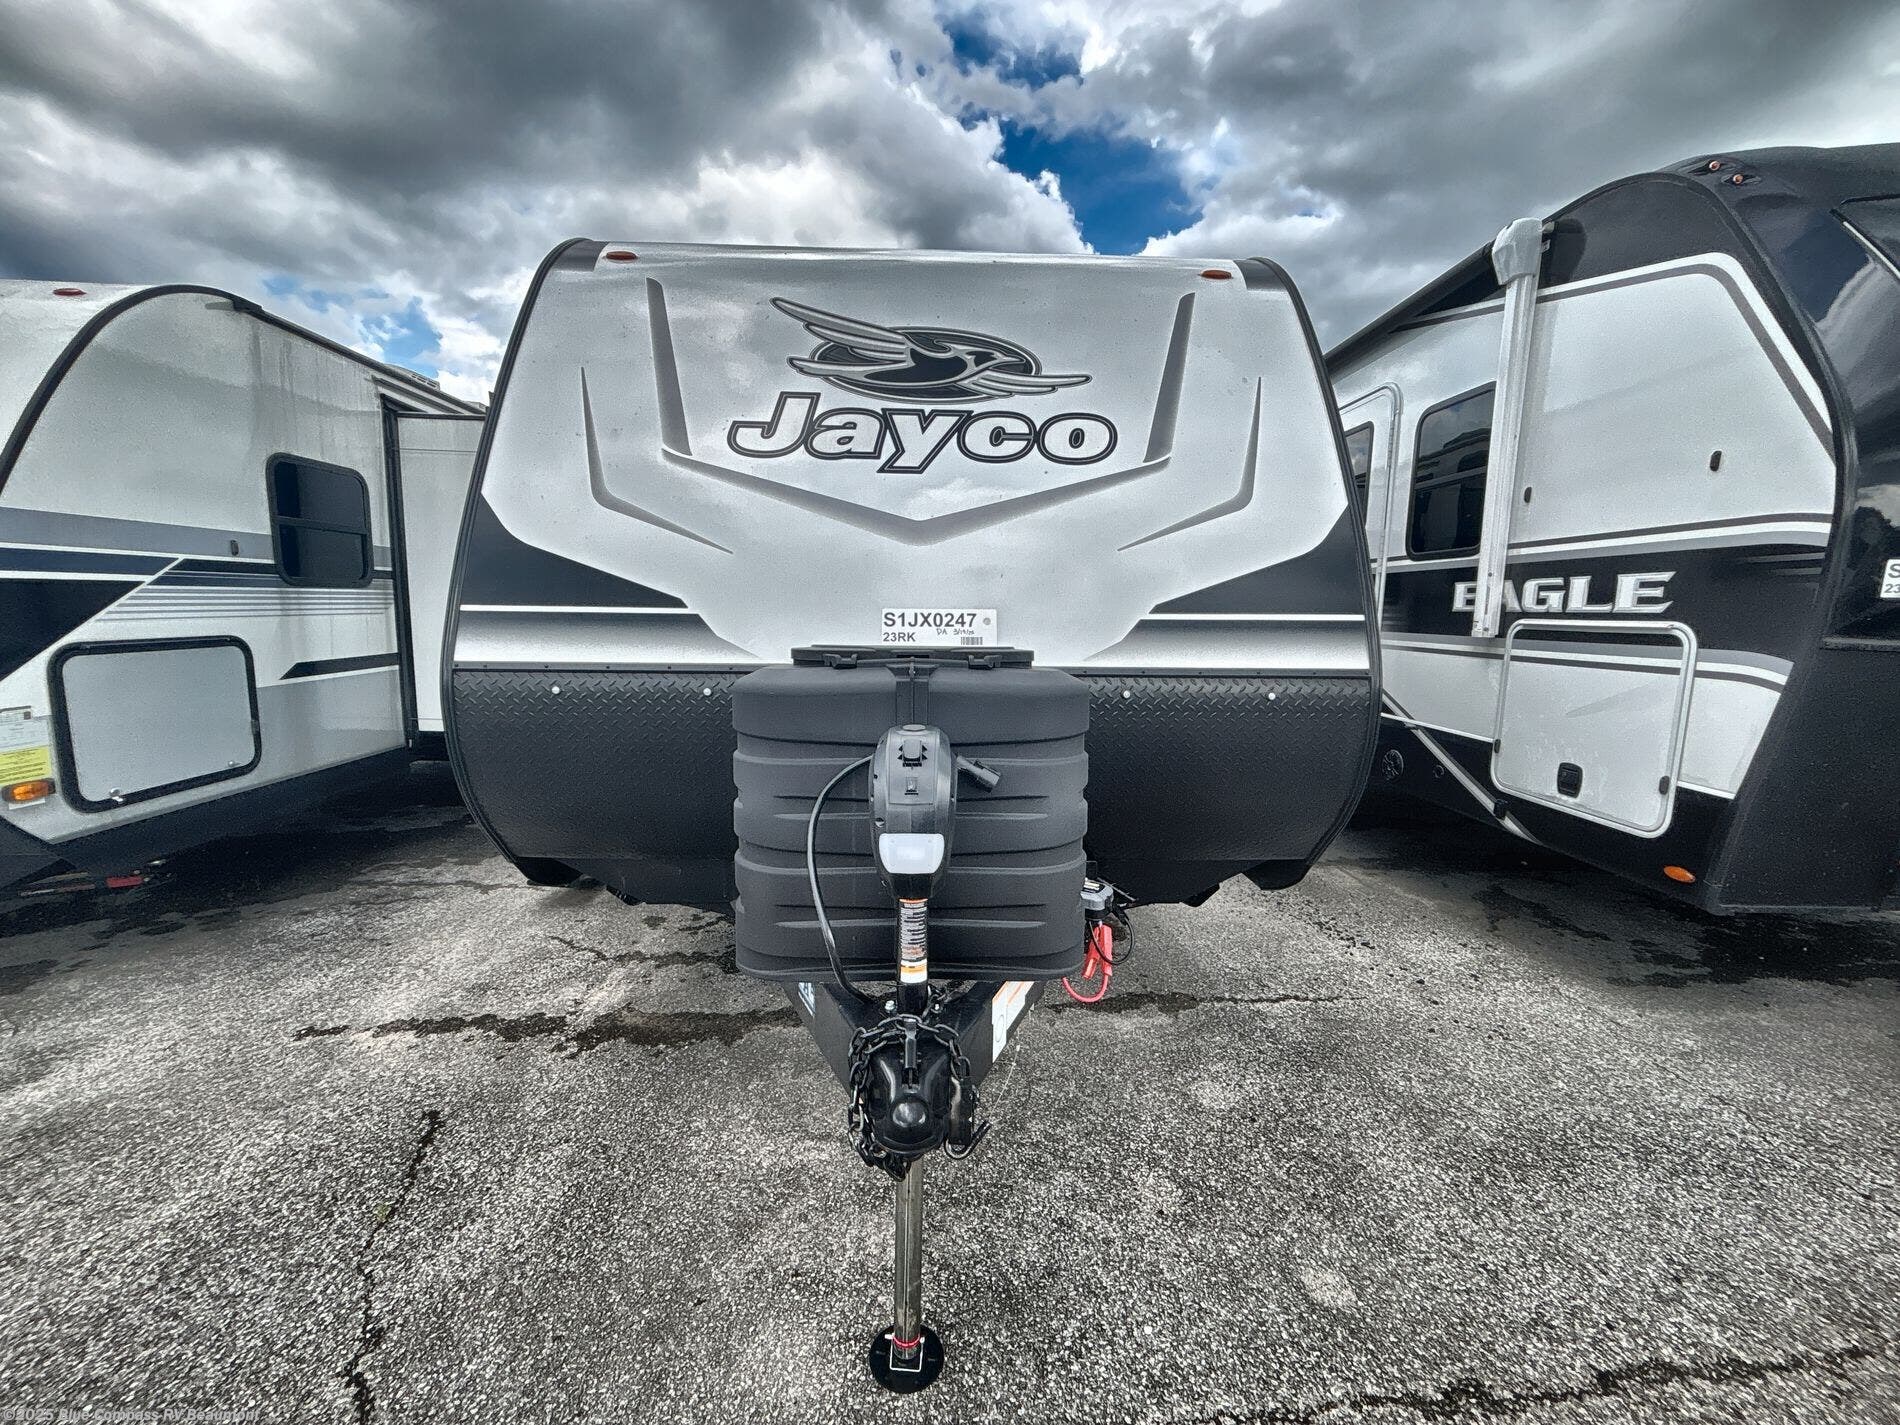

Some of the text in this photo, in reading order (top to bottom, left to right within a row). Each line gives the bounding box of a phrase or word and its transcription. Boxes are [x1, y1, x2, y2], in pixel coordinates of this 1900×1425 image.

[727, 391, 1118, 474] Jayco
[883, 612, 977, 627] S1JX0247
[883, 632, 916, 642] 23RK
